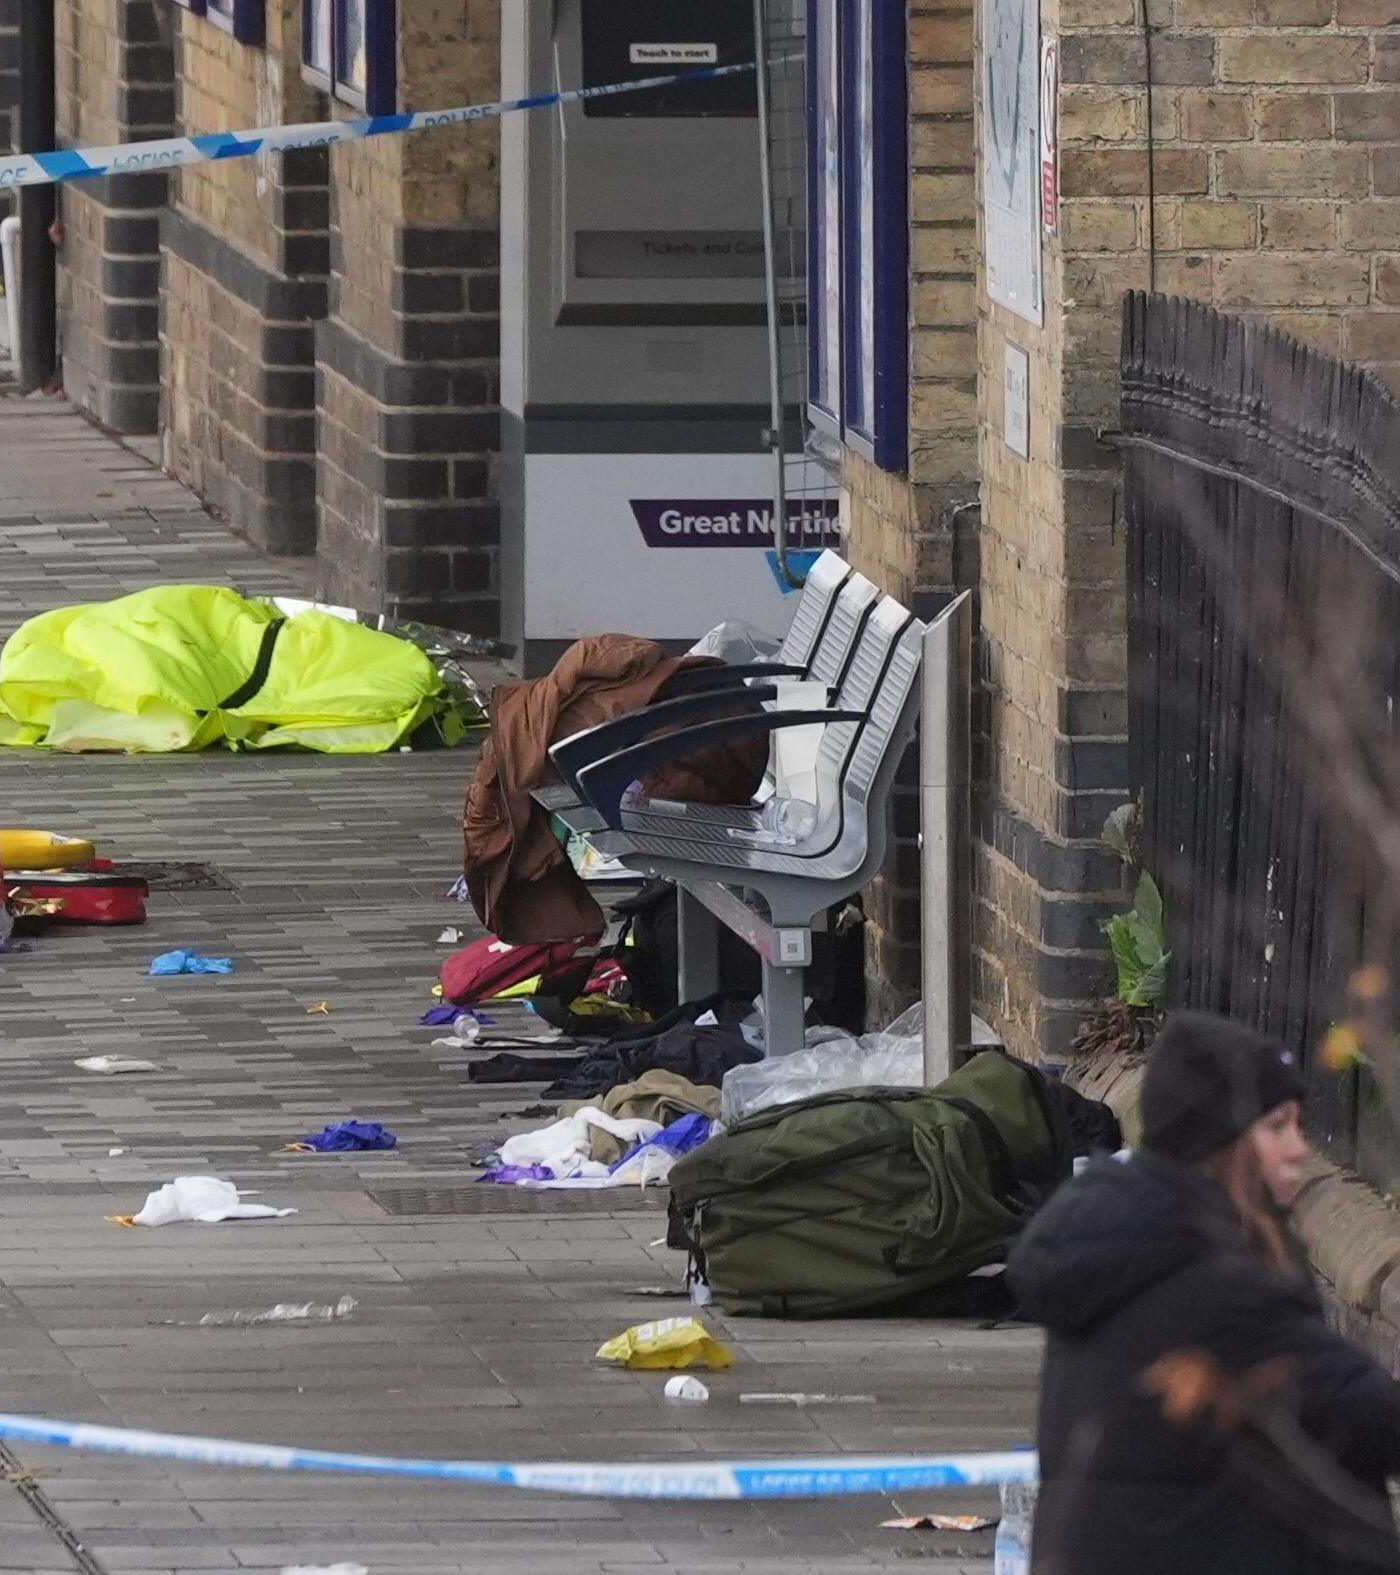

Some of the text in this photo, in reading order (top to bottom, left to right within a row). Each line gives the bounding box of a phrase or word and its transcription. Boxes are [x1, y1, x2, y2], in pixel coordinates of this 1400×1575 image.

[637, 49, 709, 58] Touch to start
[702, 241, 731, 255] and
[659, 509, 741, 535] Great
